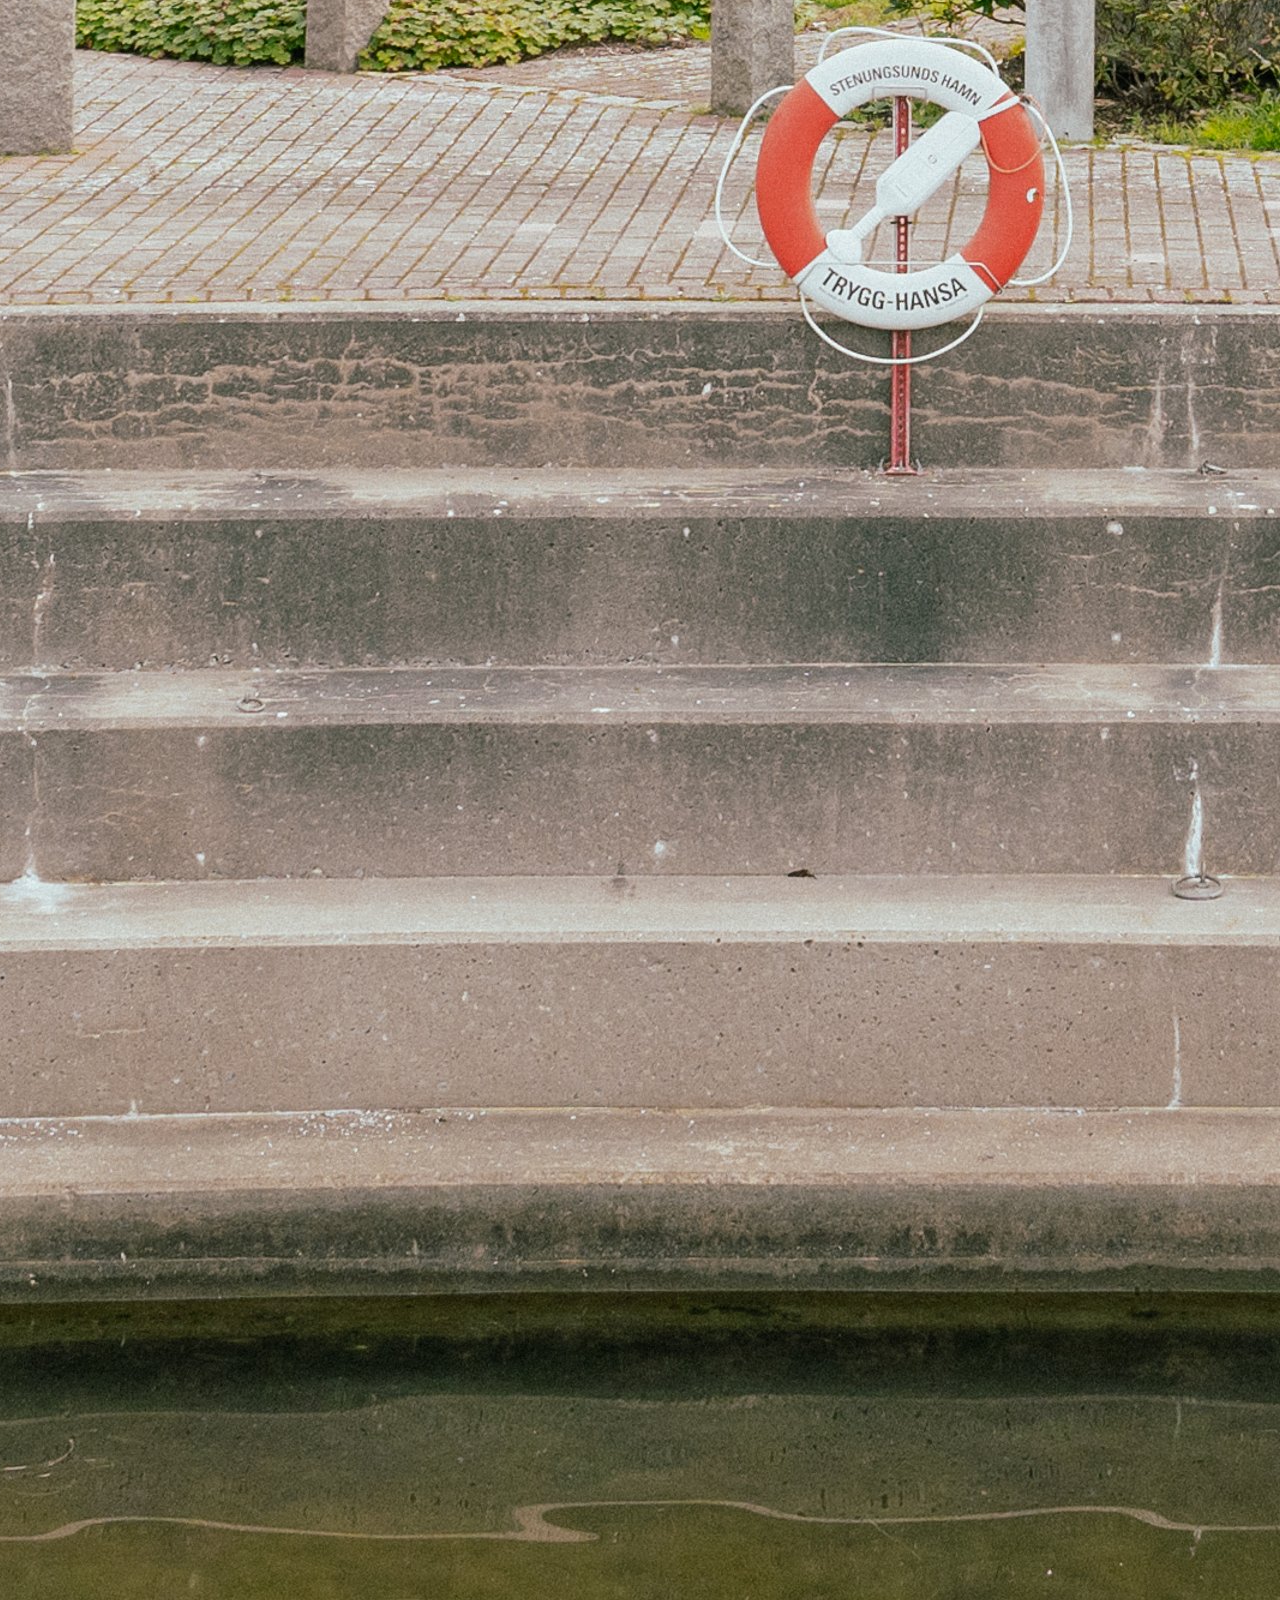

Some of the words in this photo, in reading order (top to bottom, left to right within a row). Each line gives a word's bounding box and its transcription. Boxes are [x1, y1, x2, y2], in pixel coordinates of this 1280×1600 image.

[829, 65, 940, 96] STENUNGSUNDS
[941, 74, 982, 106] HAMN
[822, 267, 967, 311] TRYGG-HANSA
